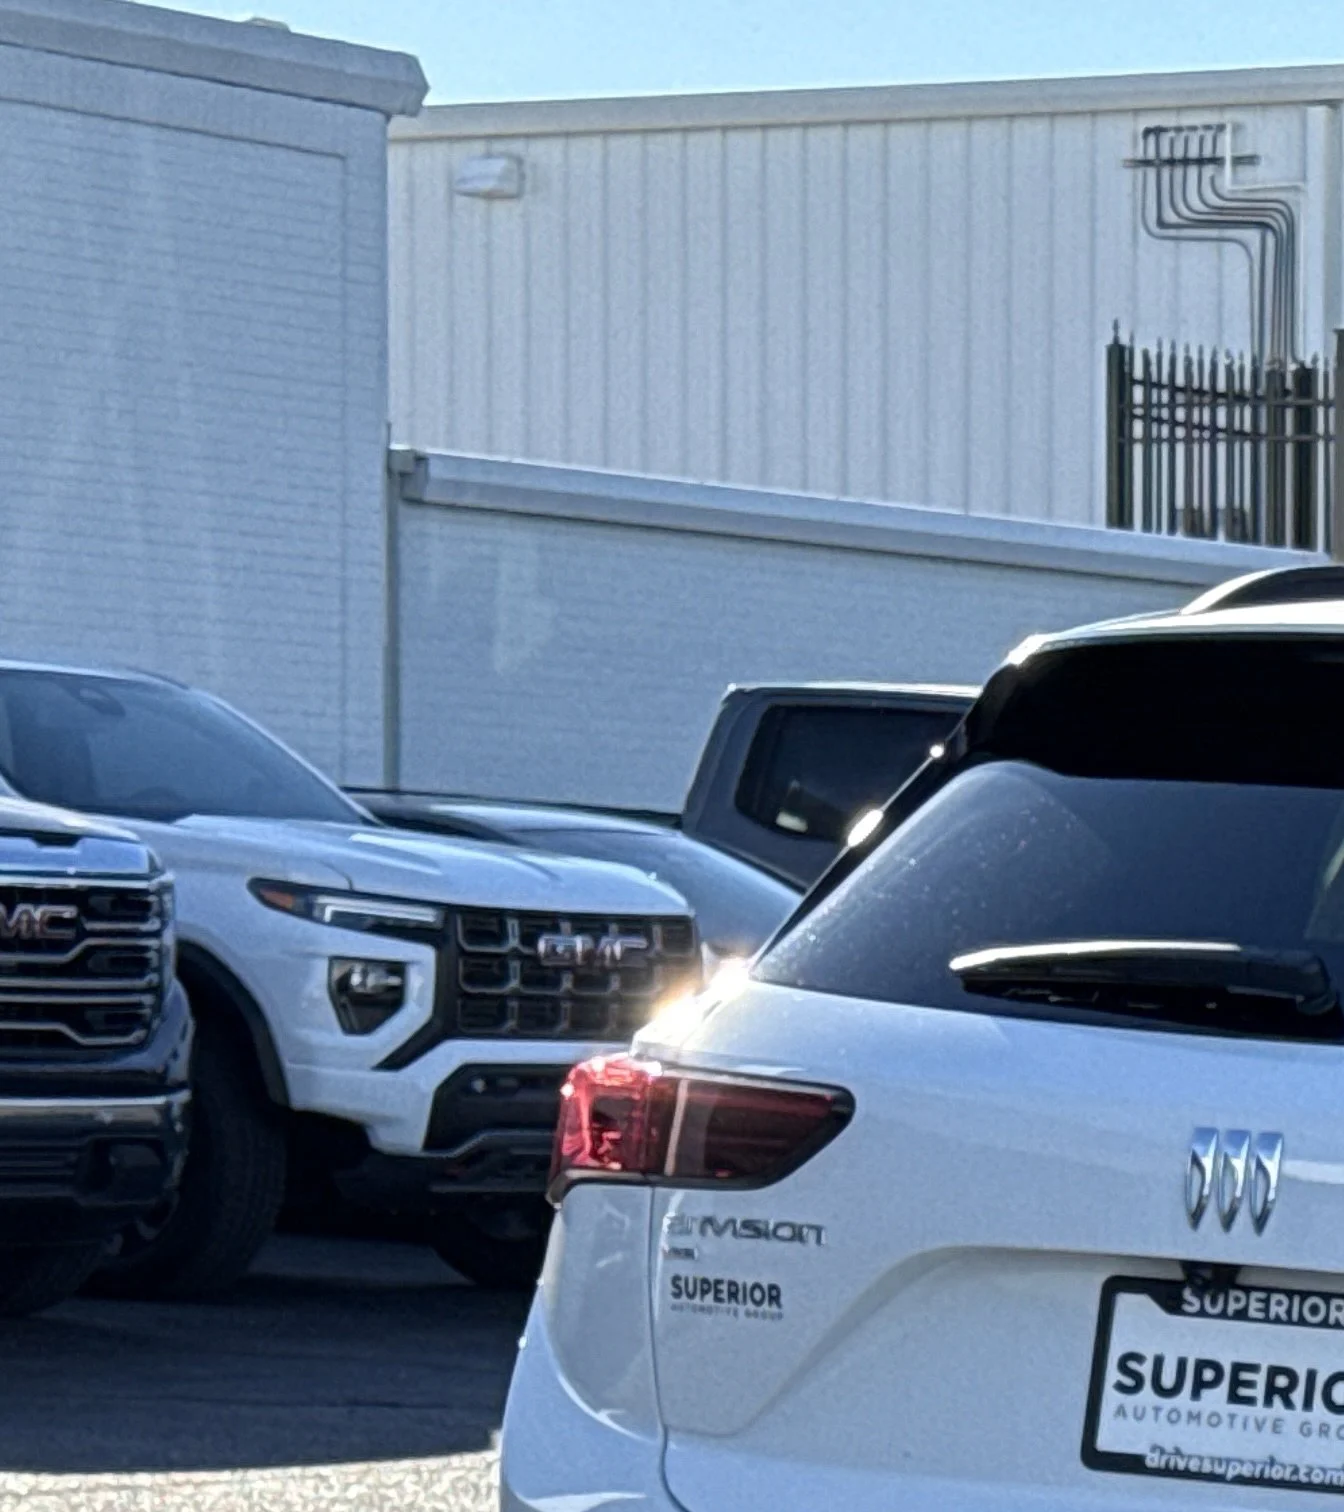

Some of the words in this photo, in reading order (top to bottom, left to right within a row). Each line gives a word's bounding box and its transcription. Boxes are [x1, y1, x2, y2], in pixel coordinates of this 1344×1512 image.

[537, 934, 648, 967] GMC
[670, 1273, 783, 1310] SUPERIOR
[1113, 1403, 1285, 1435] AUTOMOTIVE
